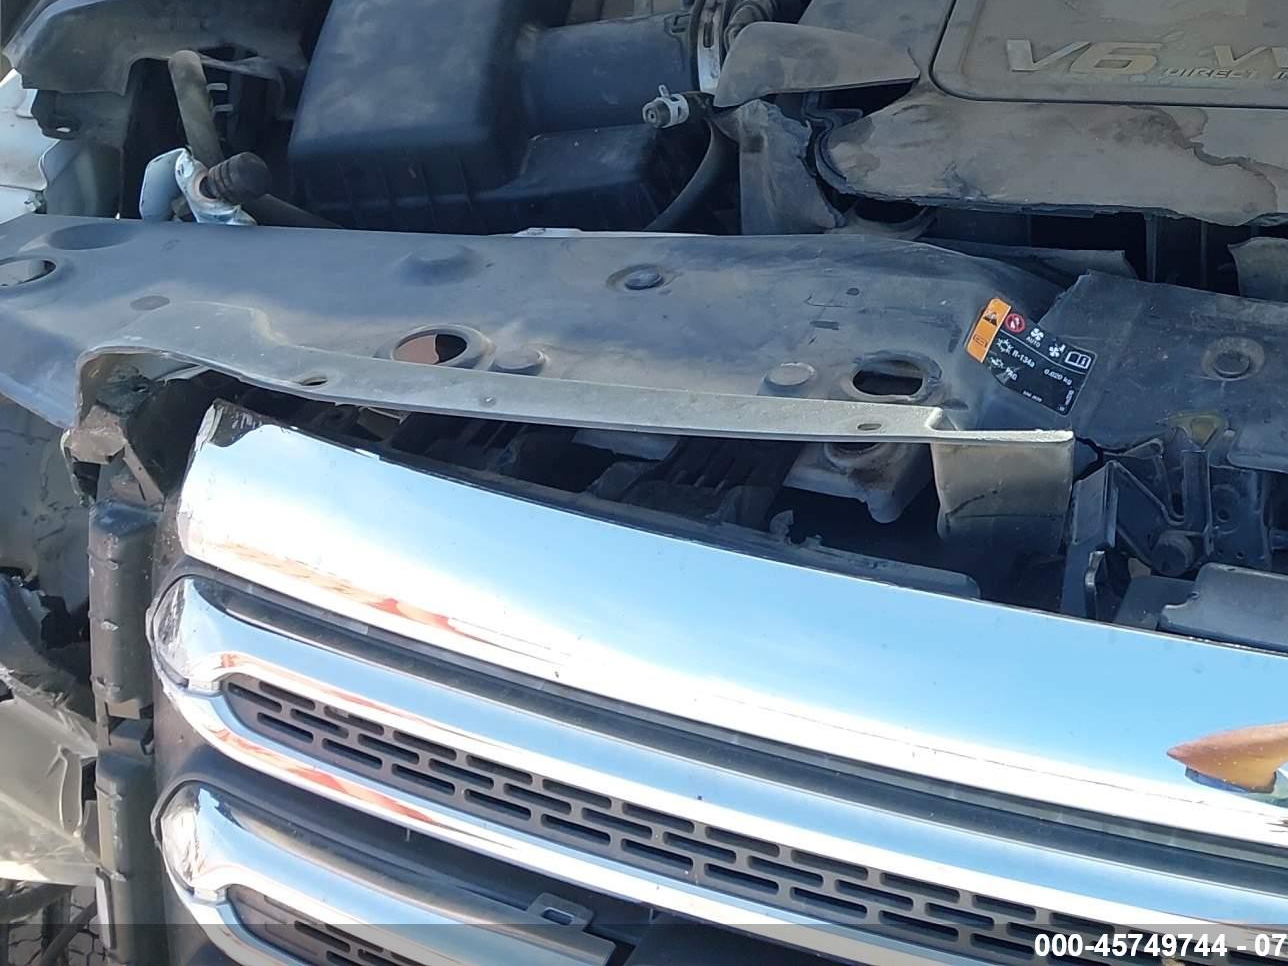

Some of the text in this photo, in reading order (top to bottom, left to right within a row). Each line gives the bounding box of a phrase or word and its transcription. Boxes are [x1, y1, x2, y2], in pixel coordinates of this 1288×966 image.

[1005, 40, 1163, 75] V6
[1026, 337, 1041, 348] AUTO
[1012, 348, 1035, 368] R-134a
[1062, 375, 1073, 386] kg
